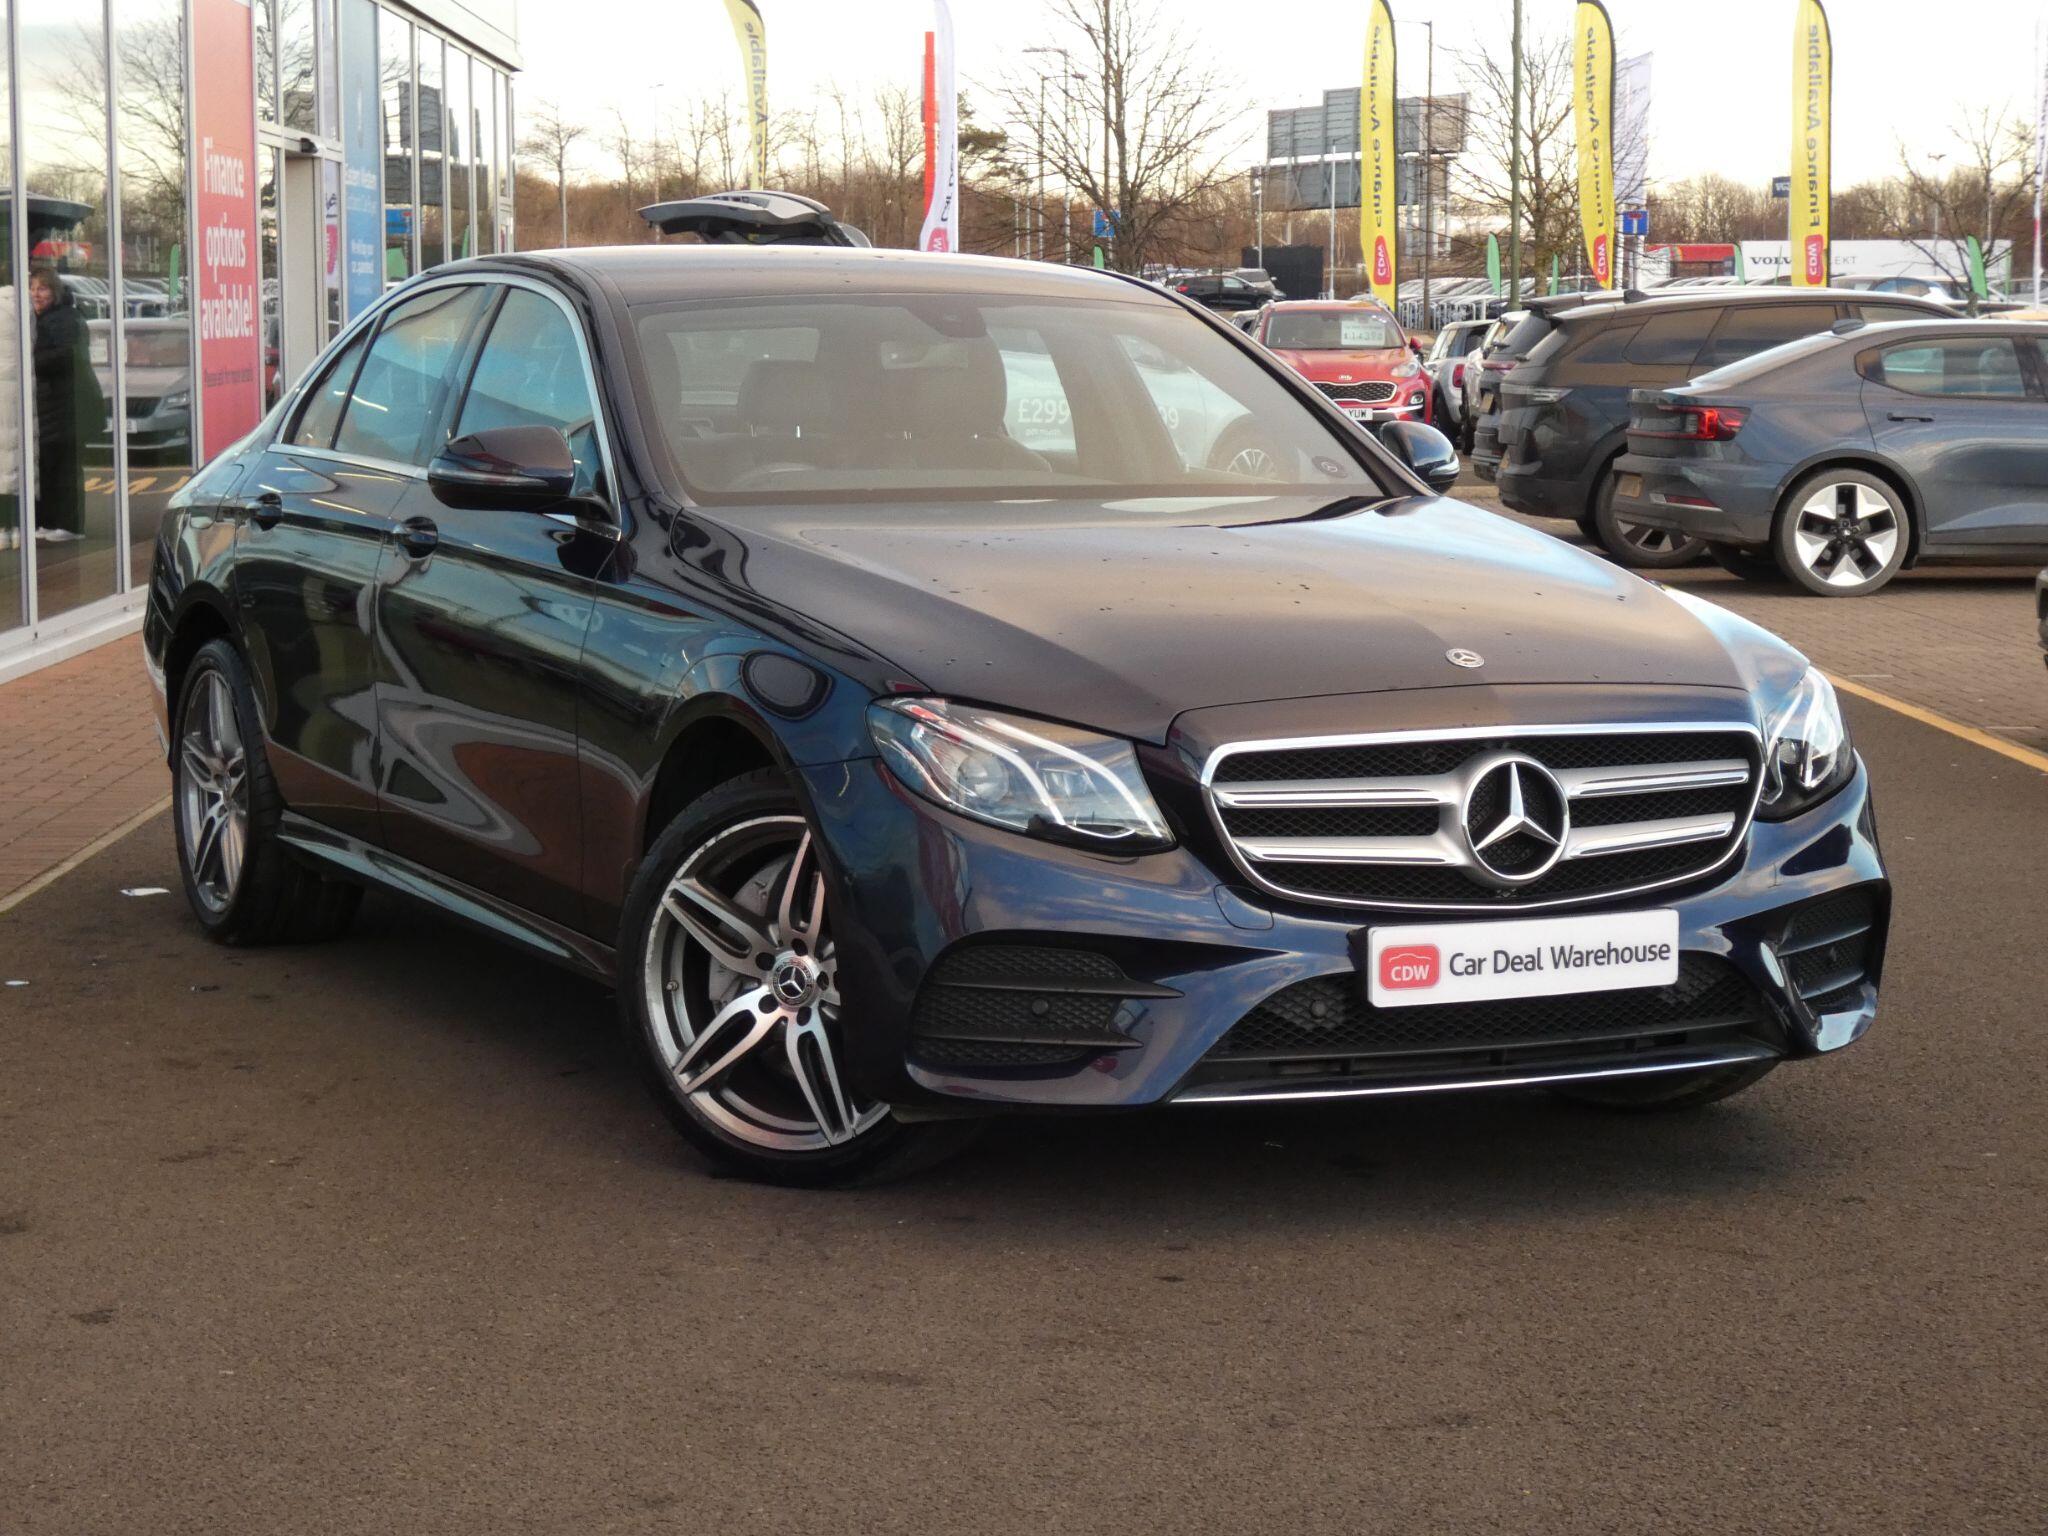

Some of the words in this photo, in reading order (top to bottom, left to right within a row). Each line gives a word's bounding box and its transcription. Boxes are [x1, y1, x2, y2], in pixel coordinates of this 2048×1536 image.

[203, 136, 245, 199] Finance
[205, 211, 247, 283] options
[1751, 256, 1792, 265] VOLV
[202, 283, 253, 340] available!
[1017, 397, 1073, 424] £299
[1390, 964, 1430, 982] CDW
[1449, 952, 1487, 976] Car
[1493, 947, 1543, 974] Deal
[1550, 941, 1671, 969] Warehouse
